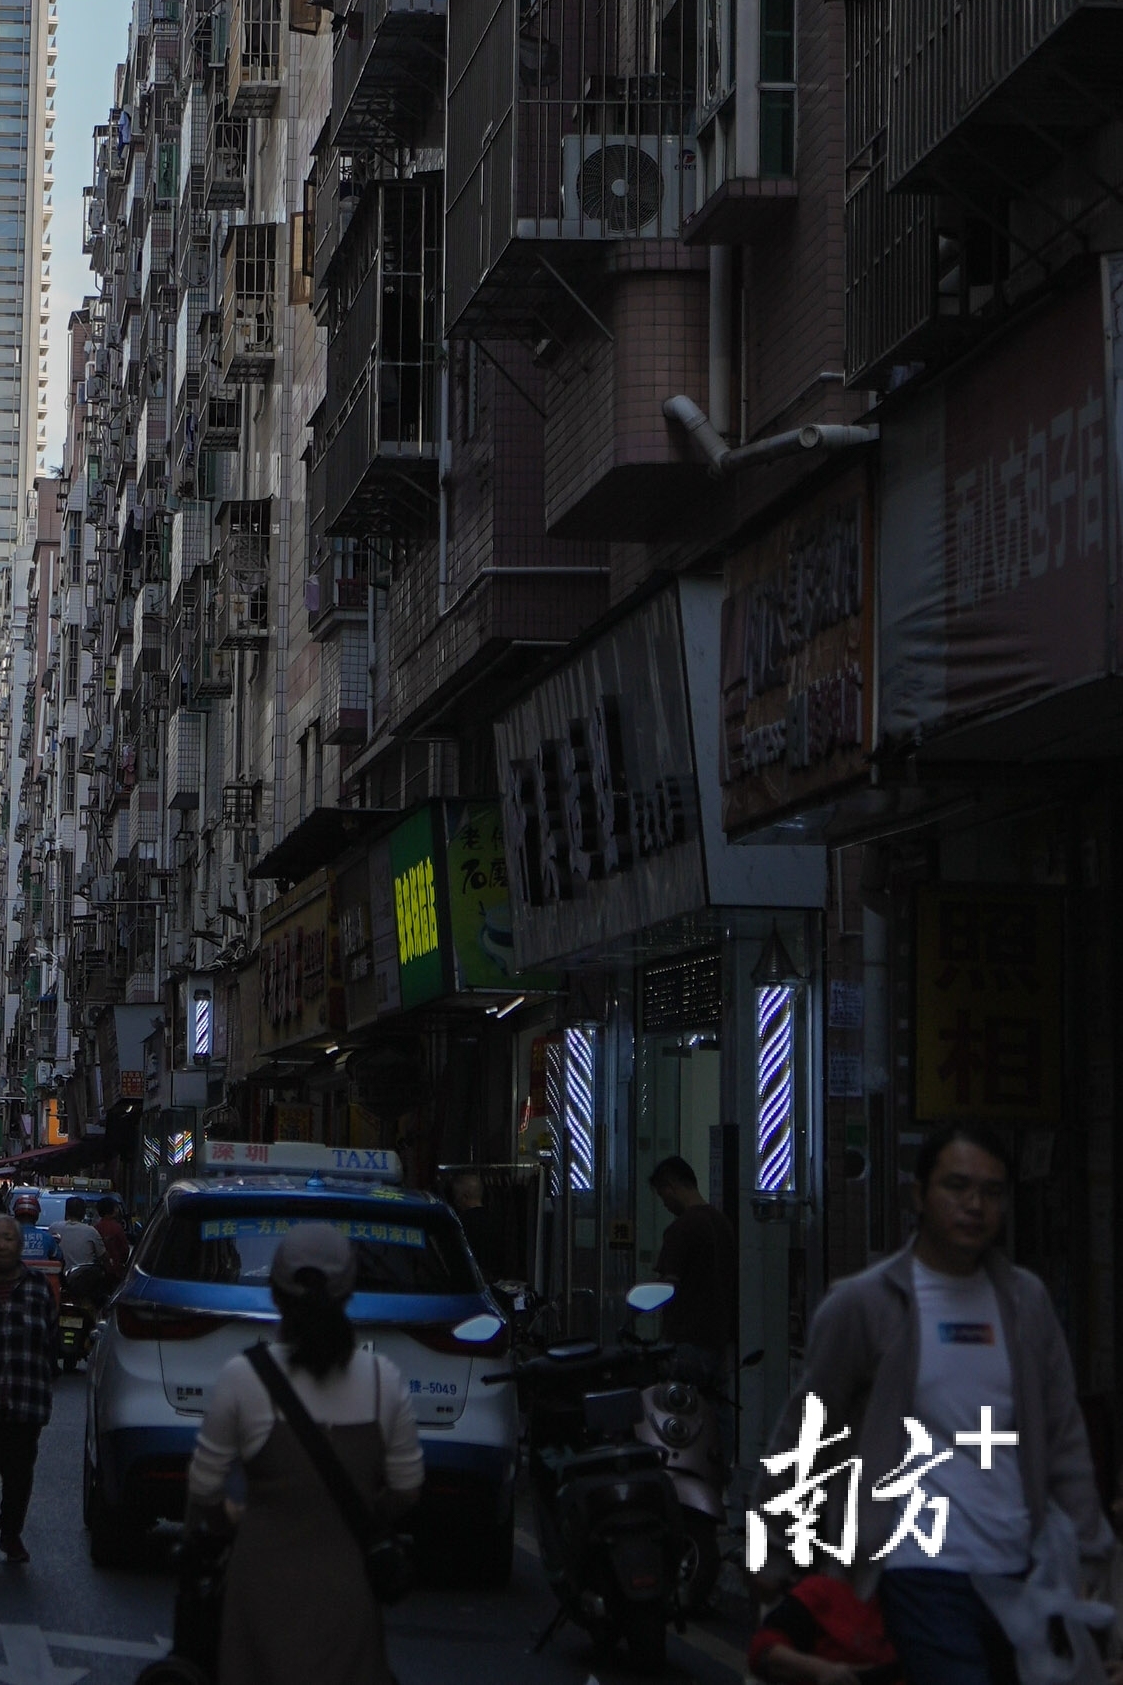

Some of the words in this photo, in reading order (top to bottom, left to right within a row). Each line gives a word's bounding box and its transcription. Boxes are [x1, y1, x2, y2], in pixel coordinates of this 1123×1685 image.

[935, 899, 1042, 1108] 照相
[212, 1143, 269, 1163] 深圳
[332, 1149, 389, 1170] TAXI
[204, 1218, 303, 1239] 同在一方热
